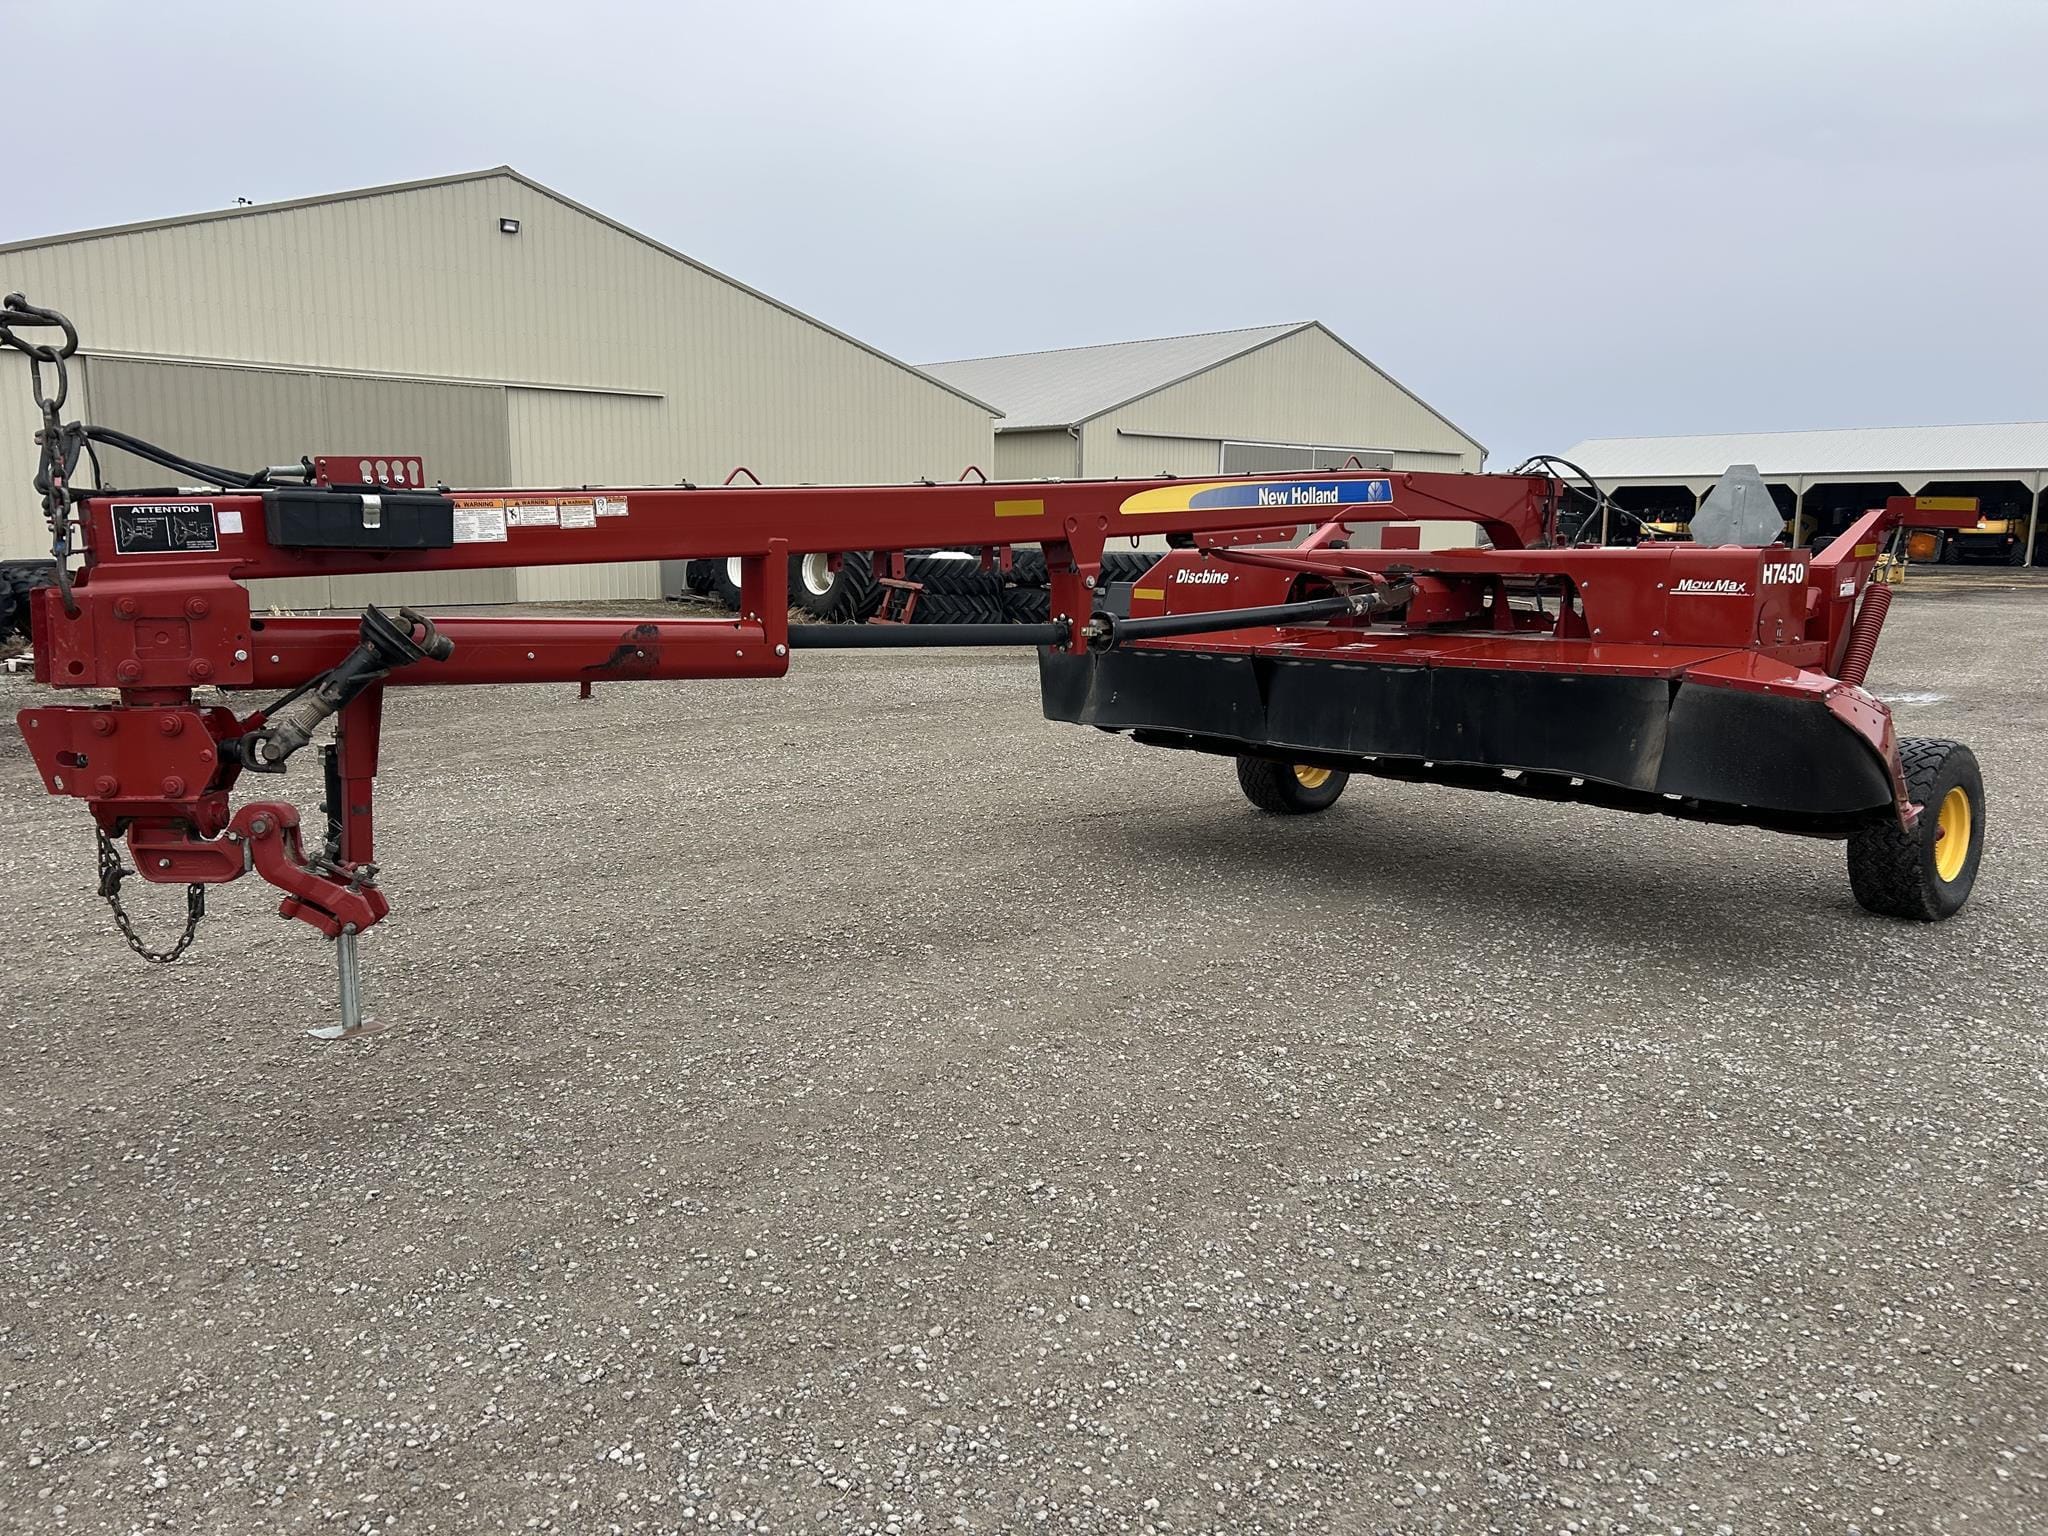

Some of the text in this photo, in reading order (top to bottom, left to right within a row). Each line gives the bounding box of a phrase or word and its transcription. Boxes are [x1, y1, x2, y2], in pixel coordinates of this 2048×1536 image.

[1258, 486, 1338, 506] New Holland
[131, 505, 200, 514] ATTENTION
[1175, 569, 1229, 584] Discbine
[1762, 563, 1804, 585] H7450
